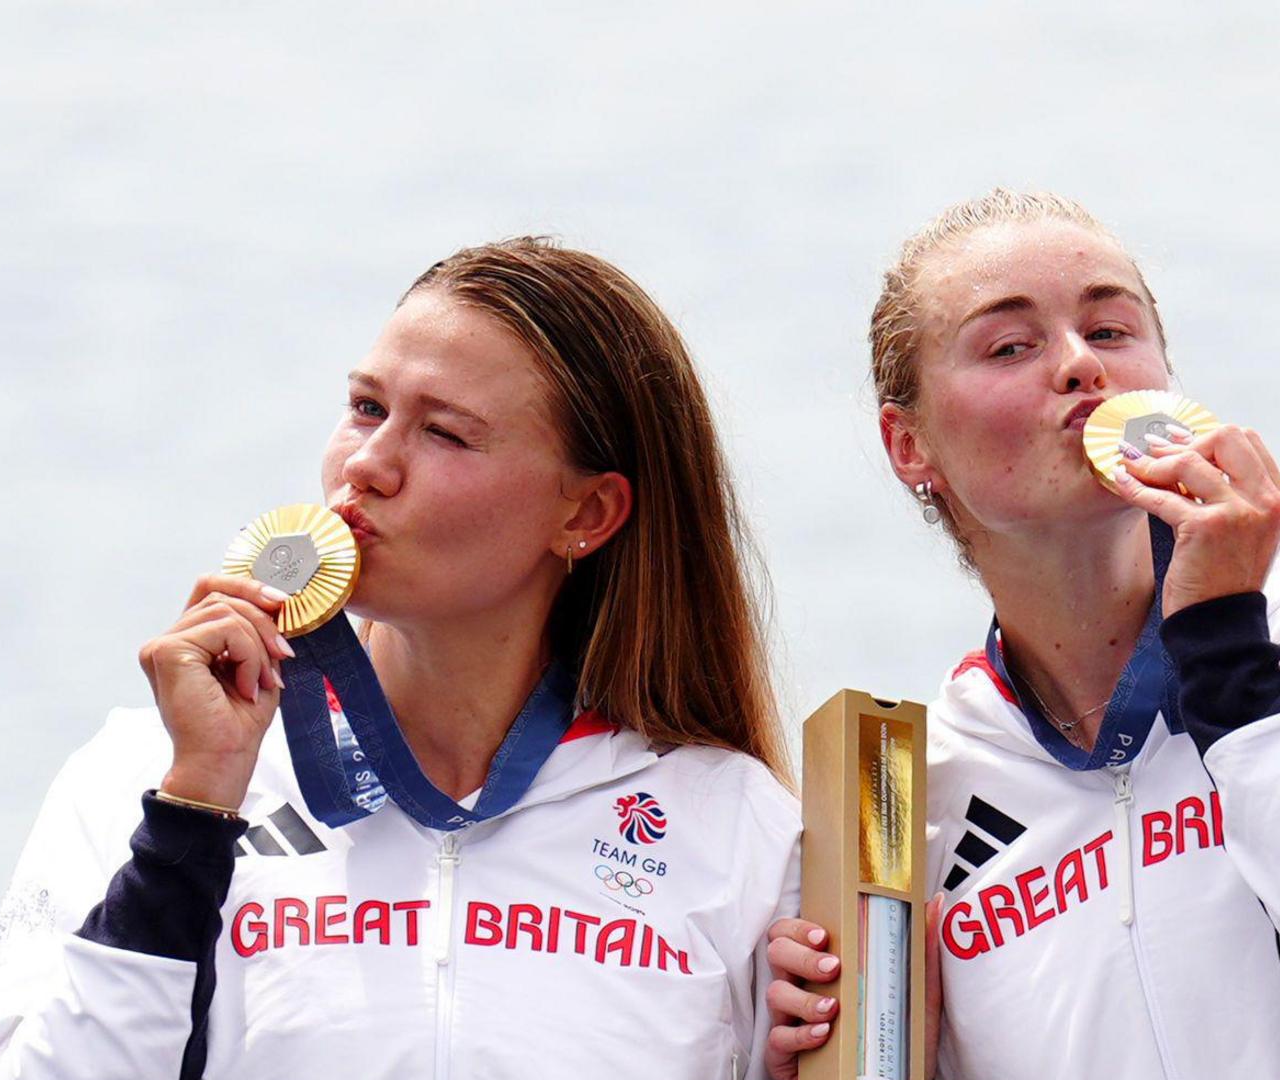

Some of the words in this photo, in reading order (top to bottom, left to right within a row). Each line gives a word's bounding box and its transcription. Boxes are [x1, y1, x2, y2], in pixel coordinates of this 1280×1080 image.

[592, 839, 638, 867] TEAM
[642, 858, 667, 876] GB
[942, 830, 1114, 960] GREAT
[231, 895, 430, 958] GREAT
[464, 901, 693, 975] BRITAIN
